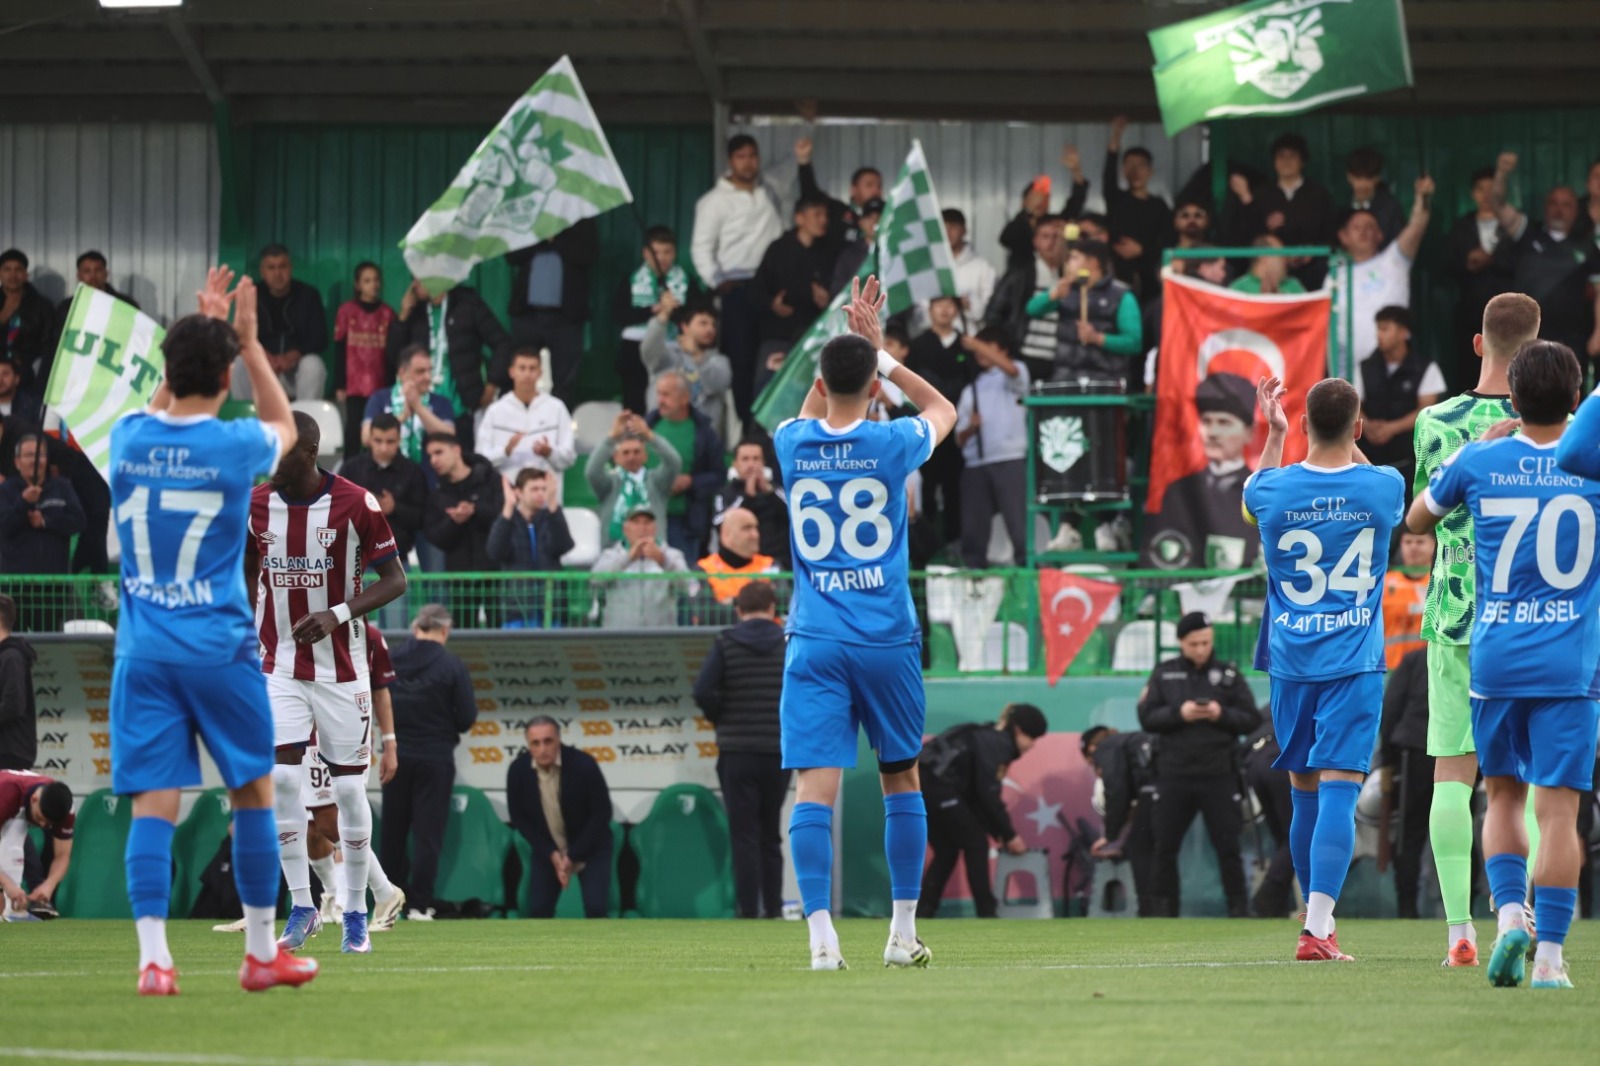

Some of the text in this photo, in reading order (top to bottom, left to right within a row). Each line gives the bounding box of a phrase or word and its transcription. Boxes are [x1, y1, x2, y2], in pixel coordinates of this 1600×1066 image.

[63, 328, 163, 404] ULT
[148, 446, 190, 466] CIP
[819, 443, 853, 460] CIP
[1518, 456, 1557, 474] CIP
[1312, 496, 1346, 512] CIP
[790, 477, 893, 561] 68
[117, 484, 225, 583] 17
[1479, 493, 1596, 593] 70
[263, 556, 334, 570] ASLANLAR
[1277, 527, 1377, 607] 34
[275, 573, 321, 586] BETON
[1514, 597, 1580, 623] BİLSEL
[1275, 607, 1371, 633] A.AYTEMUR
[608, 676, 678, 686] TALAY
[498, 695, 571, 706] TALAY
[610, 695, 682, 706] TALAY
[360, 716, 370, 745] 7
[614, 716, 686, 729] TALAY
[617, 742, 689, 756] TALAY
[310, 767, 331, 788] 92
